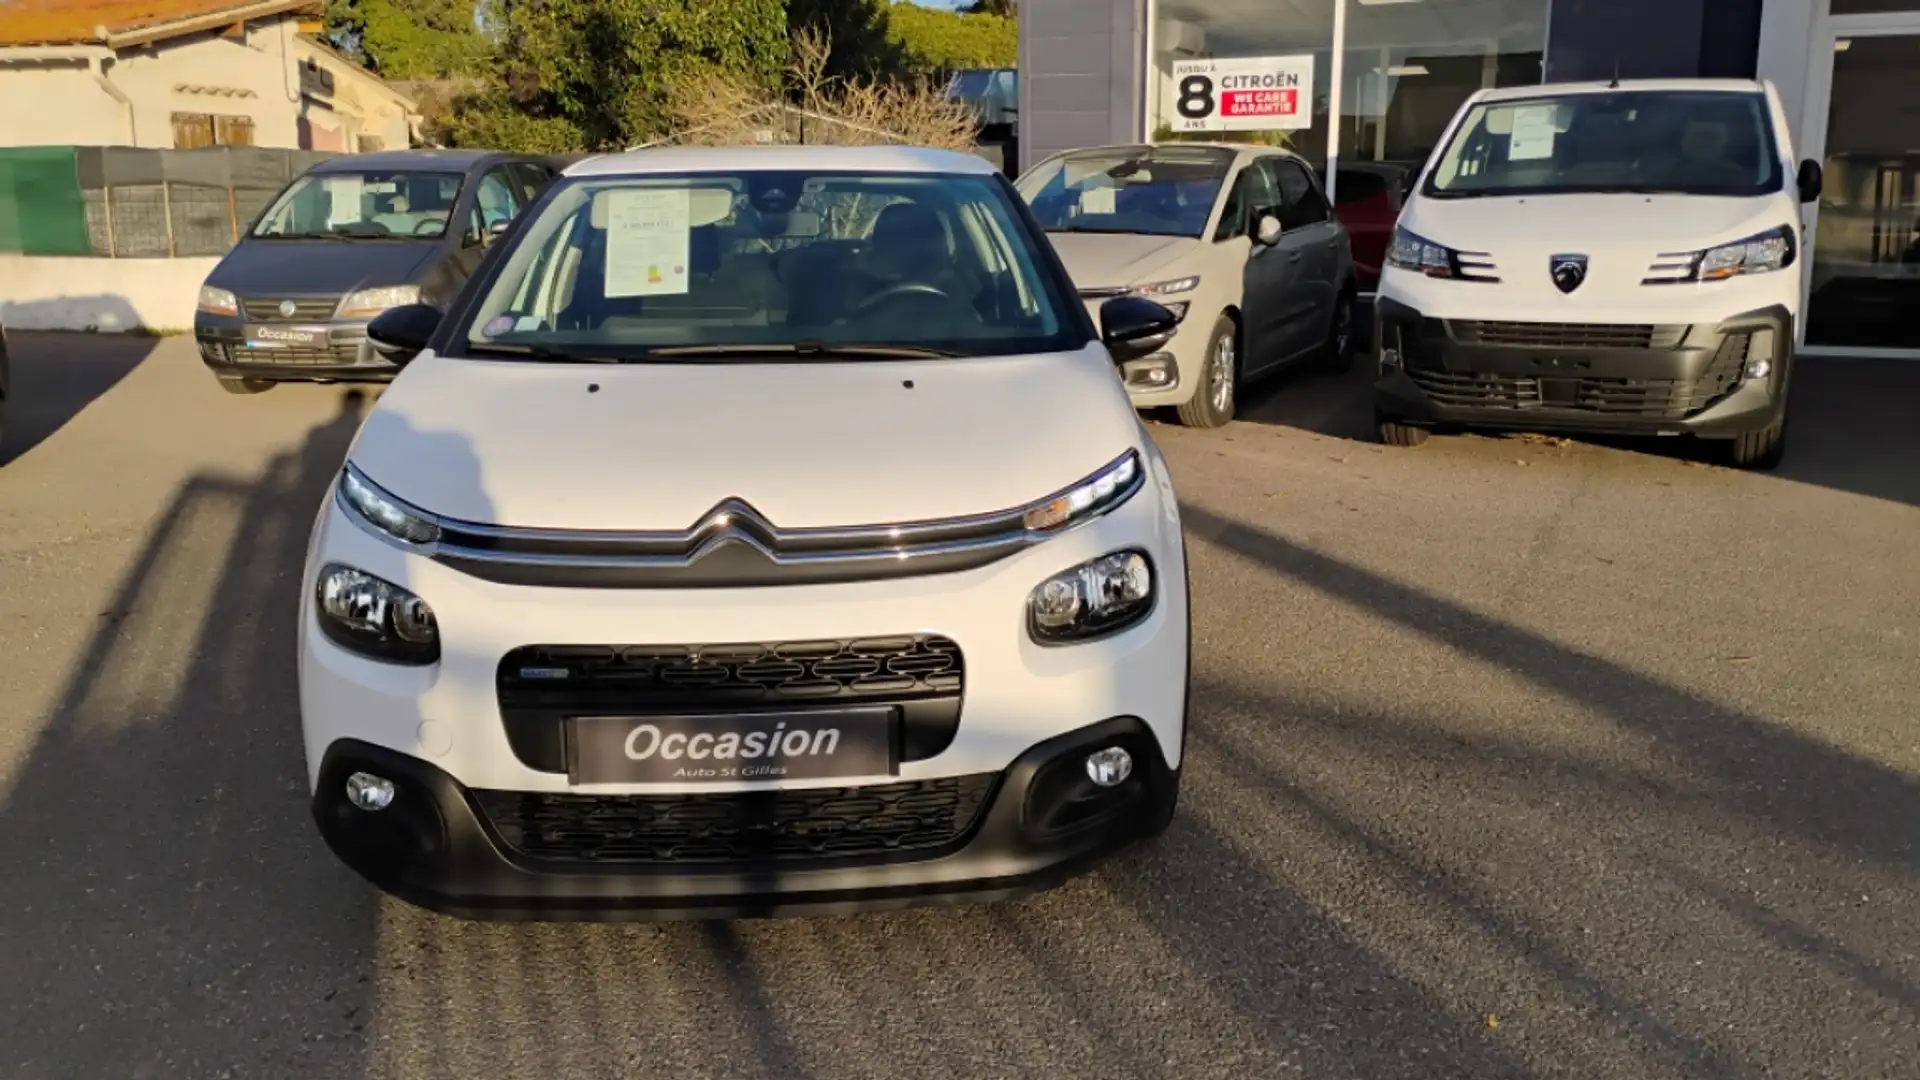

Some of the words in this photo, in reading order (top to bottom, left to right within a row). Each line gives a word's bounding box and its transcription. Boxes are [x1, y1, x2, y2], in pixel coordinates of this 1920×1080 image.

[1221, 70, 1299, 88] CITROËN
[1177, 75, 1215, 119] 8
[1233, 93, 1253, 103] WE
[1255, 91, 1288, 103] CARE
[1231, 103, 1292, 114] GARANTIE
[1184, 121, 1207, 129] ANS
[257, 326, 313, 342] Occasion
[624, 722, 840, 760] Occasion
[673, 767, 716, 777] Auto
[720, 766, 737, 776] St
[741, 765, 788, 776] Gilles
